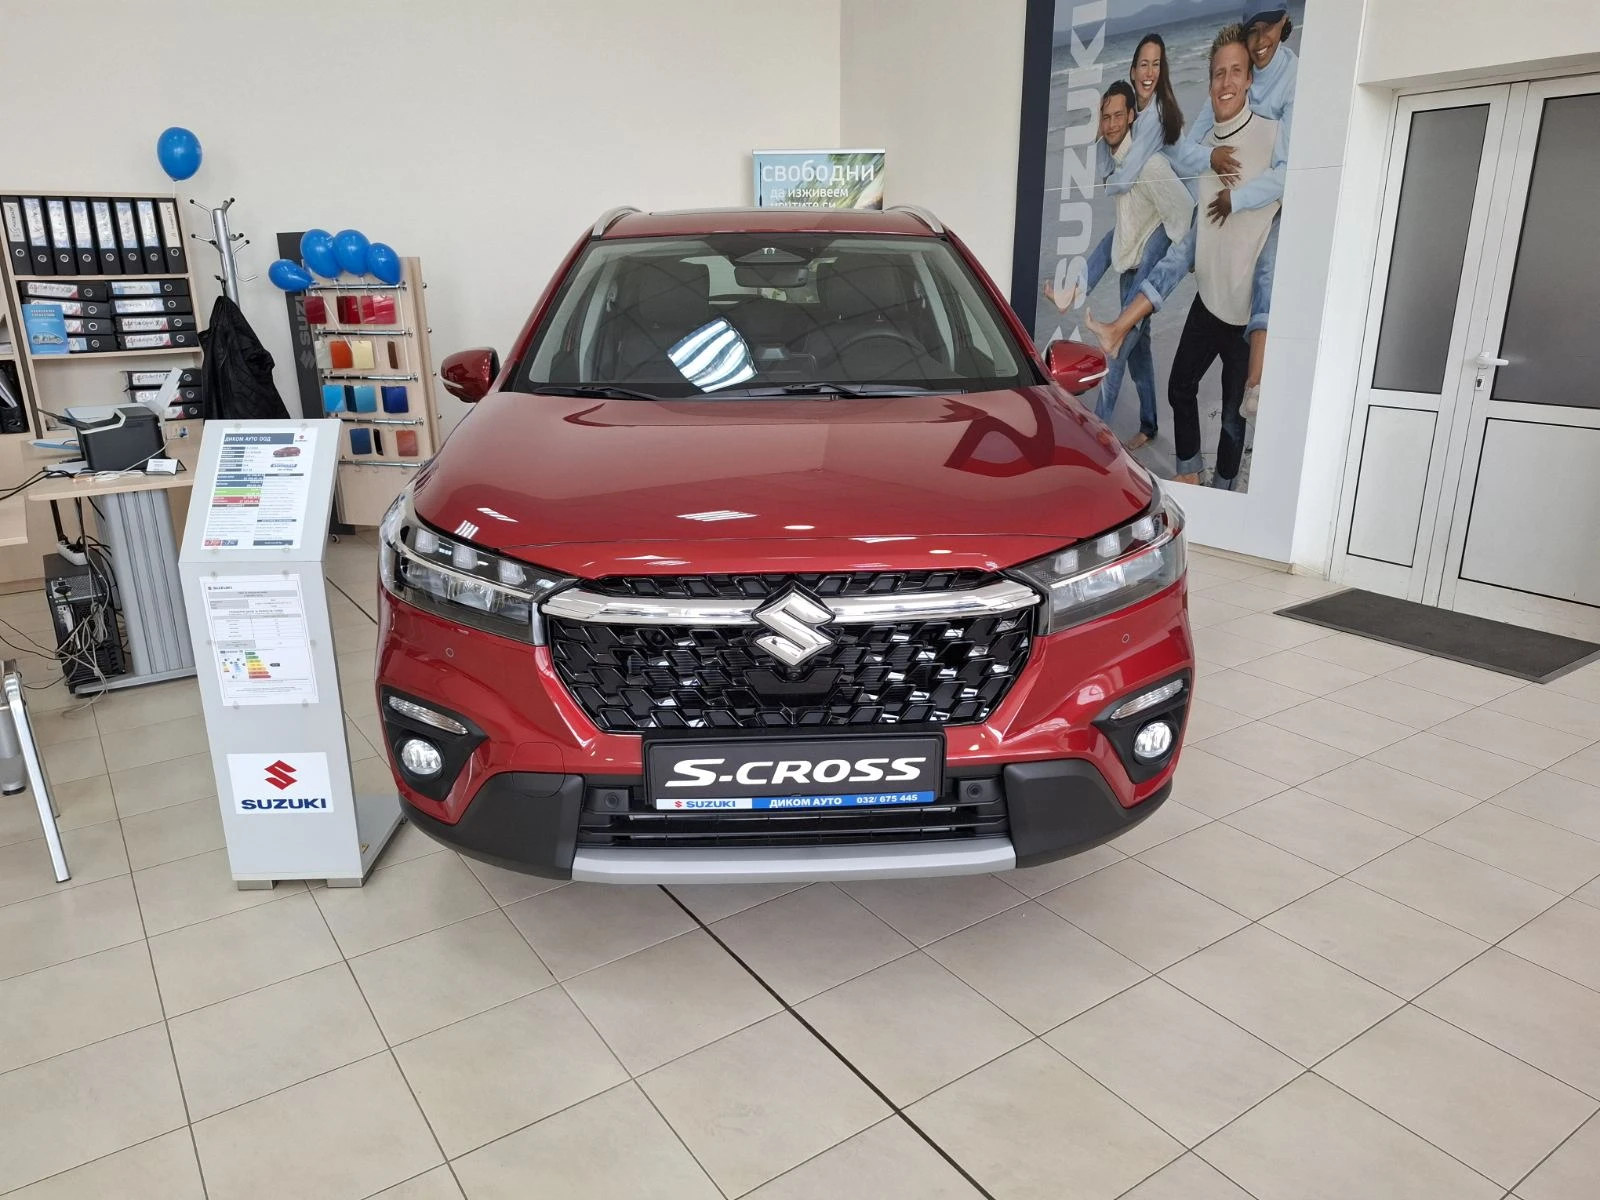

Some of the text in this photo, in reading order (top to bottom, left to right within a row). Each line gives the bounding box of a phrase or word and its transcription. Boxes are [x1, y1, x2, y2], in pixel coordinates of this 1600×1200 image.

[1054, 2, 1107, 310] SUZUKI
[761, 160, 875, 185] свободни
[770, 188, 849, 199] да изживеем
[664, 757, 926, 787] S-CROSS
[241, 798, 327, 810] SUZUKI
[686, 800, 736, 808] SUZUKI
[769, 794, 918, 809] ДИКОМ АУТО 032/ 675 445
